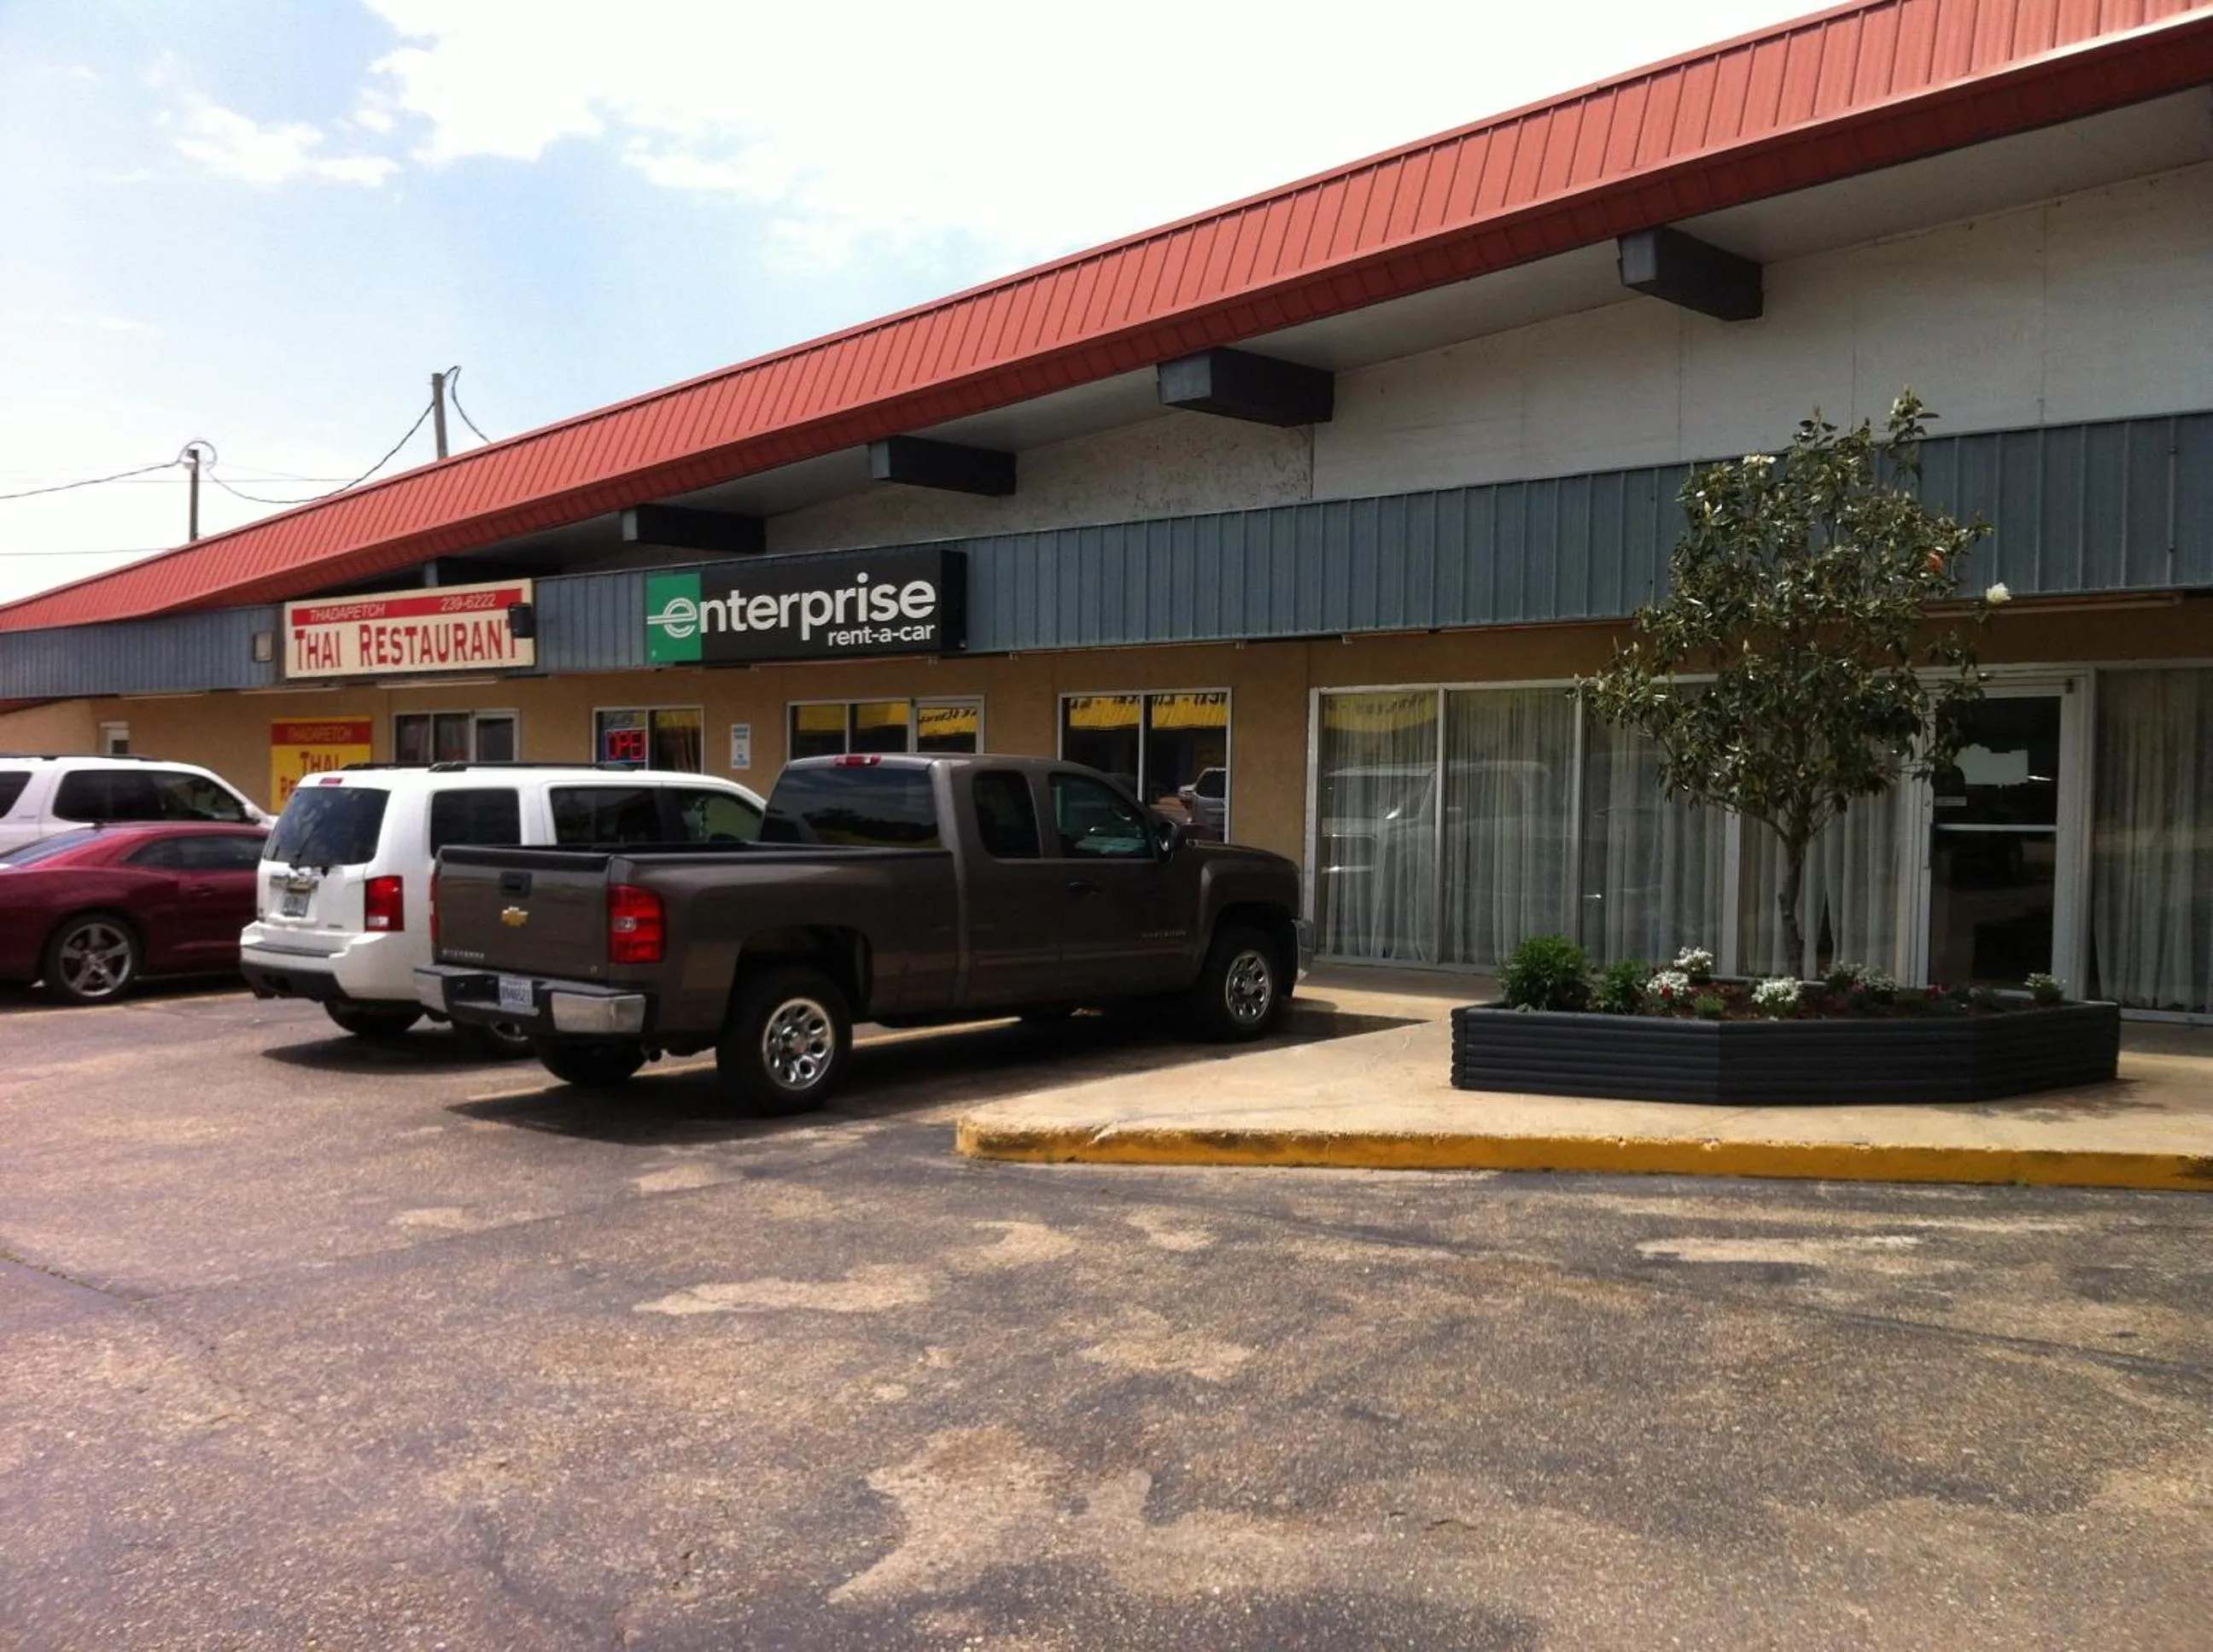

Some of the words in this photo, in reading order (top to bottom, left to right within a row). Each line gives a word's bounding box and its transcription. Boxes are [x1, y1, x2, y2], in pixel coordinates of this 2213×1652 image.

[309, 603, 386, 622] THADAPETCH
[647, 572, 936, 640] enterprise
[827, 622, 936, 646] rent-a-car
[295, 628, 342, 670] THAI
[300, 751, 340, 774] THAI
